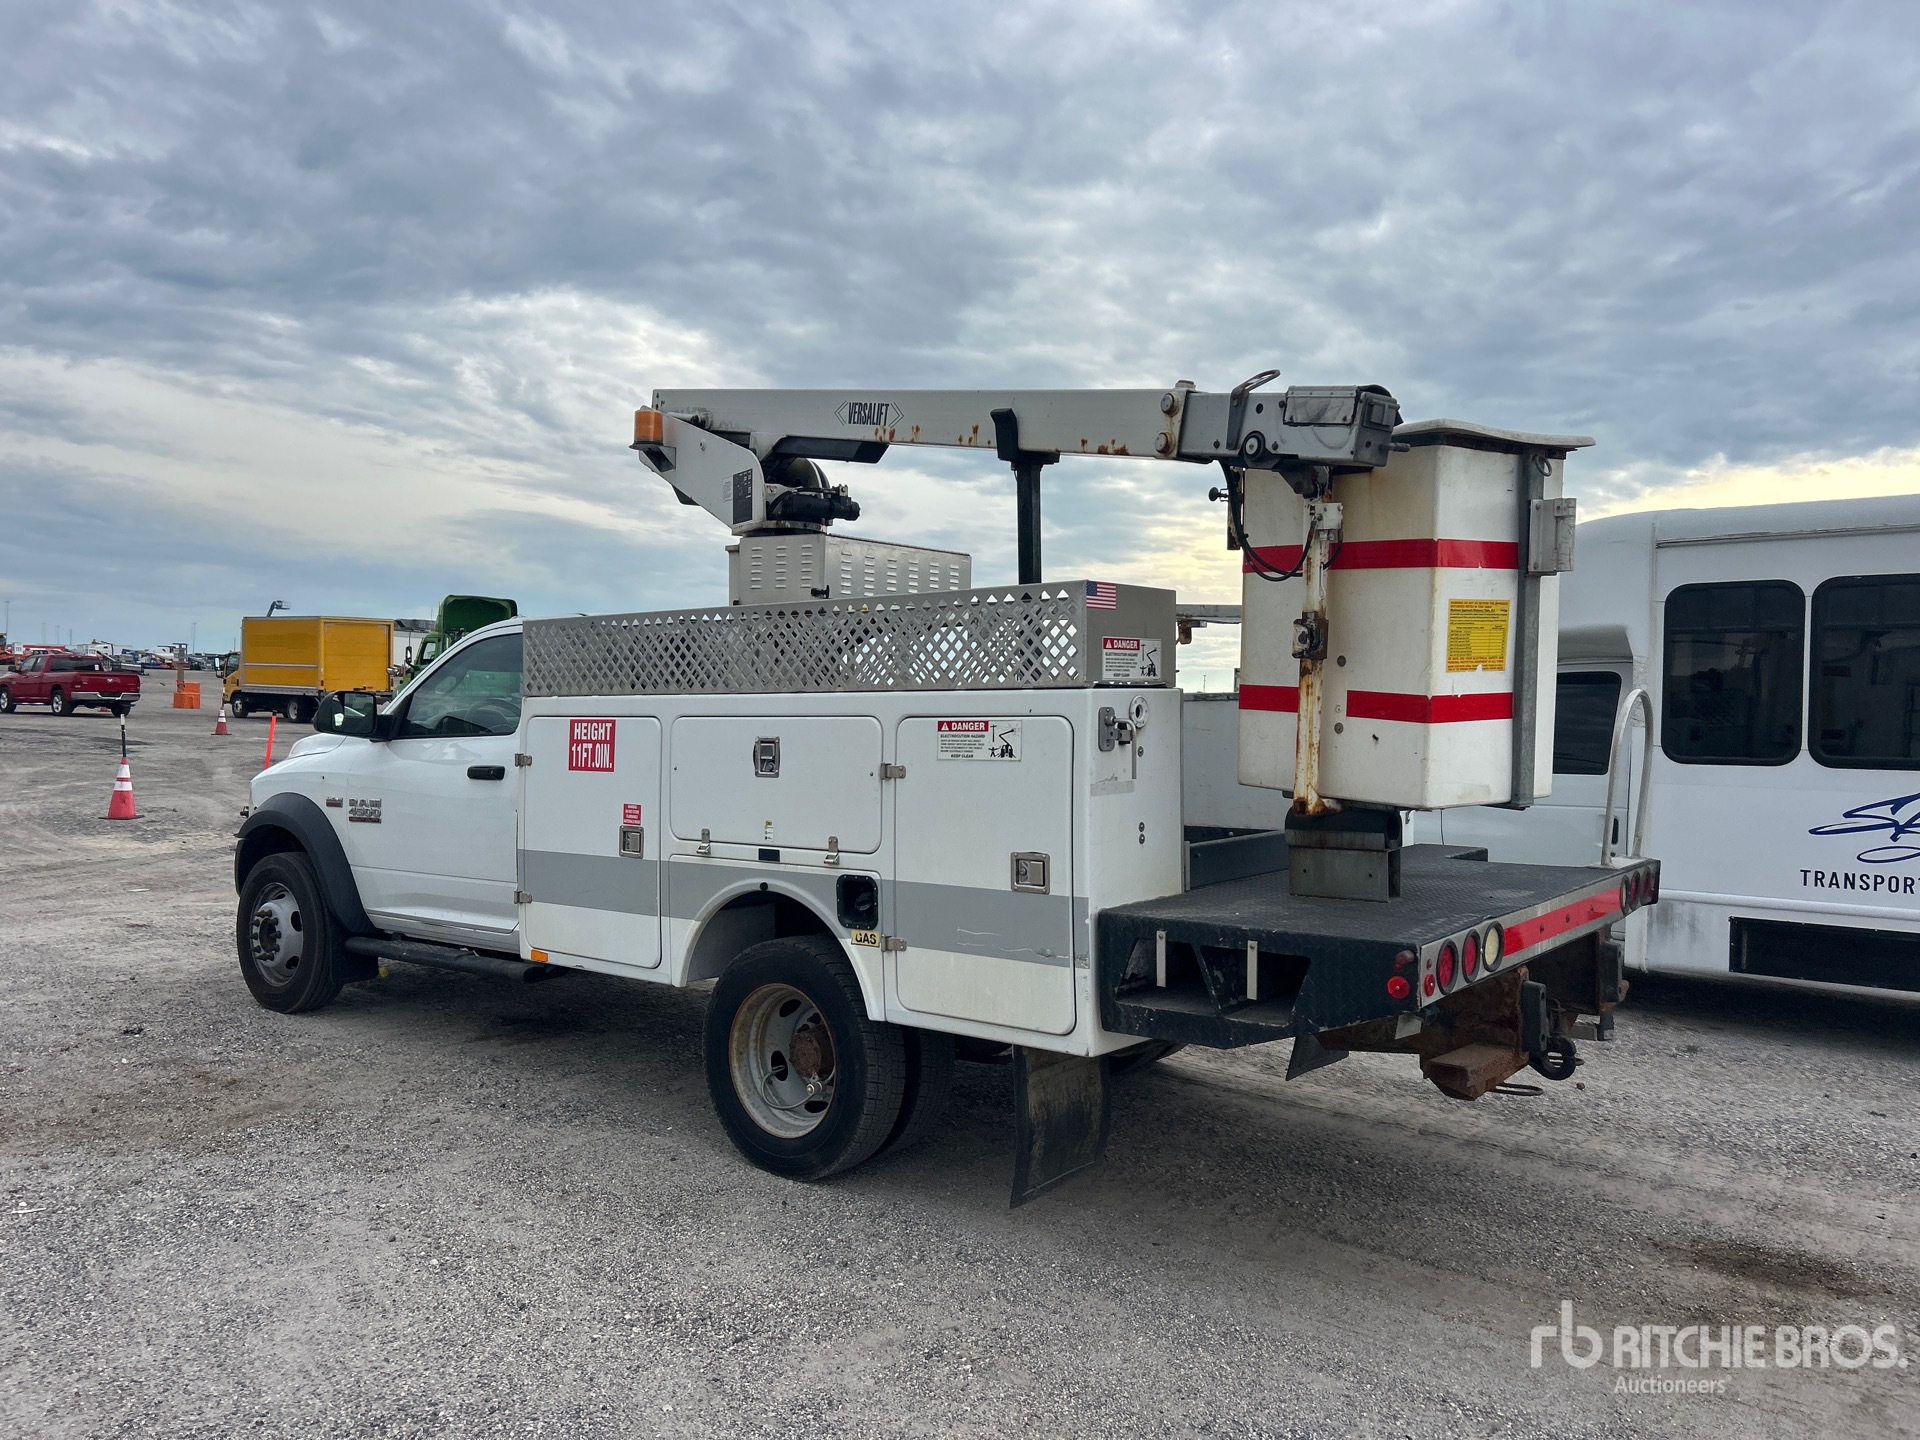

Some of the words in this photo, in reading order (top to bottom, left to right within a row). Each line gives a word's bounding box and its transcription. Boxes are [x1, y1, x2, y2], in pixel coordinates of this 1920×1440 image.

[848, 402, 889, 426] VERSALIFT
[1113, 639, 1138, 649] DANGER
[574, 722, 612, 741] HEIGHT
[951, 721, 985, 731] DANGER
[1800, 868, 1920, 895] TRANSPOR
[855, 932, 877, 945] GAS
